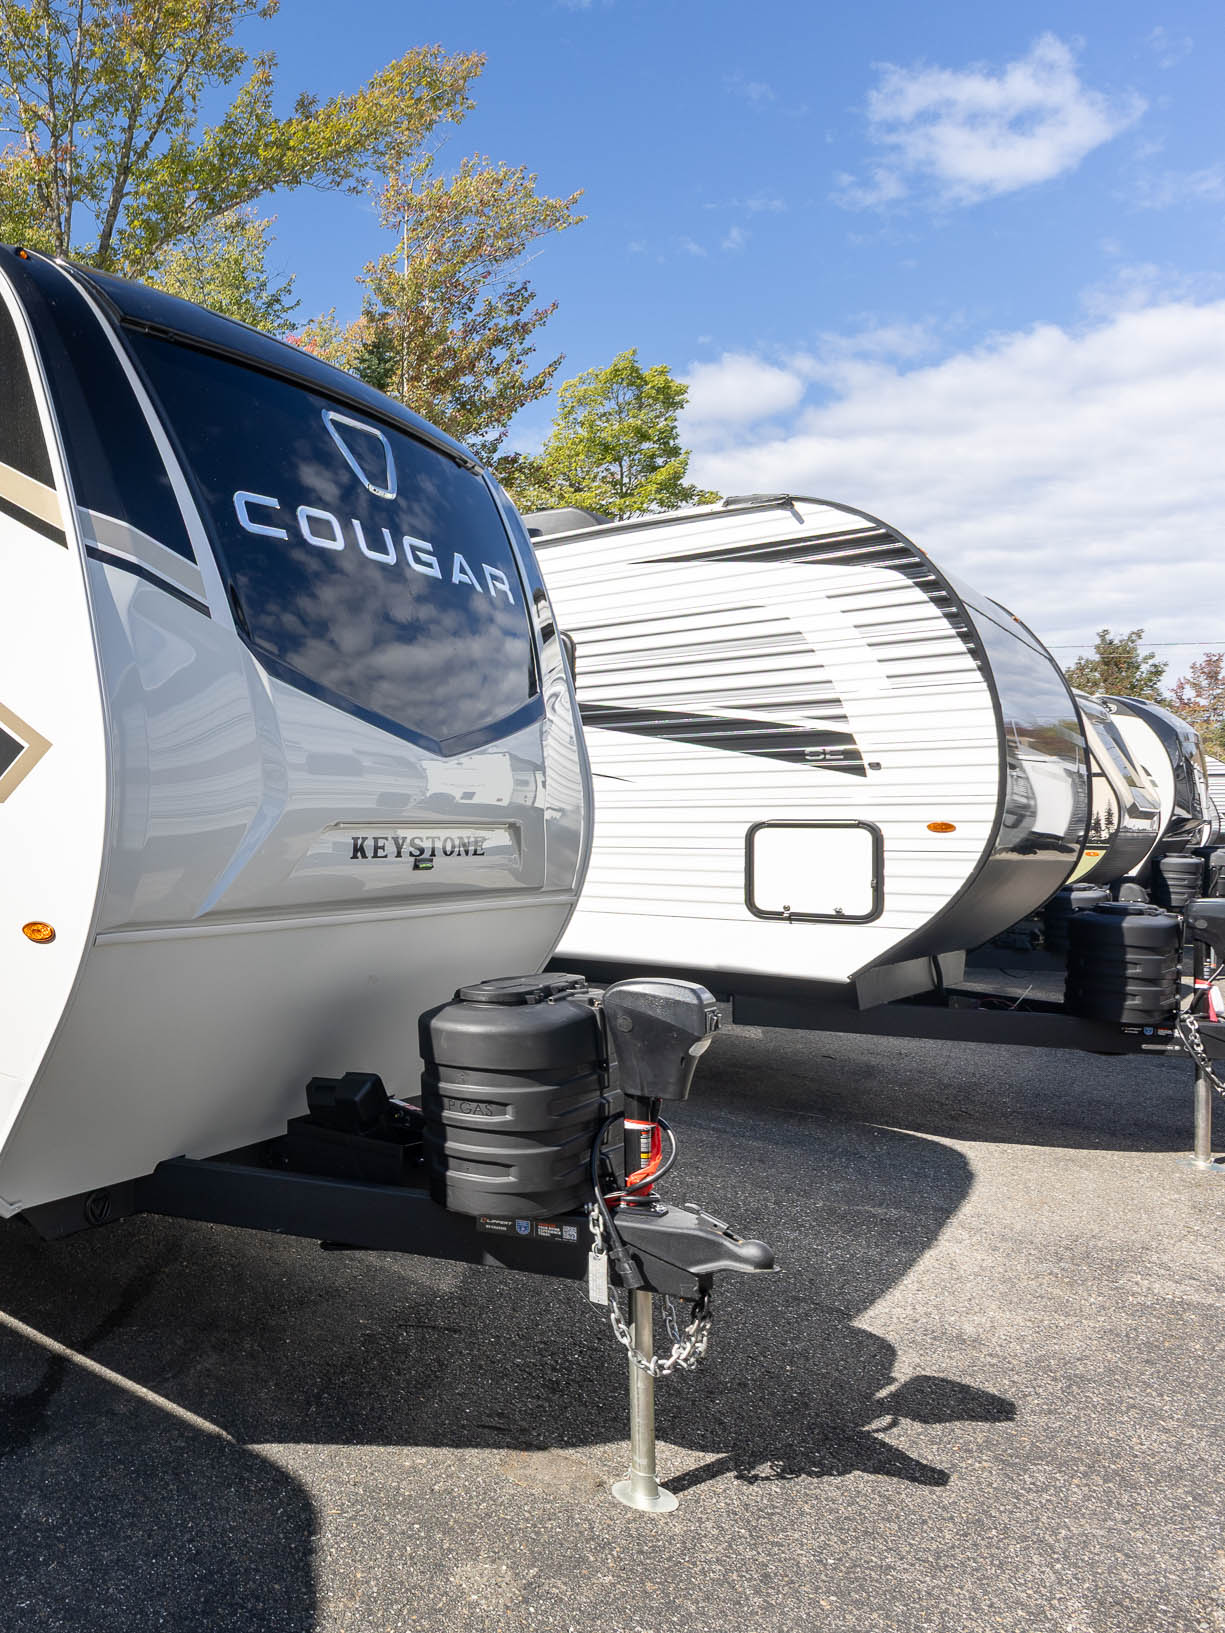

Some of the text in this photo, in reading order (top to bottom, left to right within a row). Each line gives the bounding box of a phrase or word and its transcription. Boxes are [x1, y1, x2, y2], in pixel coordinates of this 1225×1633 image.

[233, 490, 515, 605] COUGAR
[350, 835, 488, 860] KEYSTONE
[460, 1101, 492, 1117] GAS
